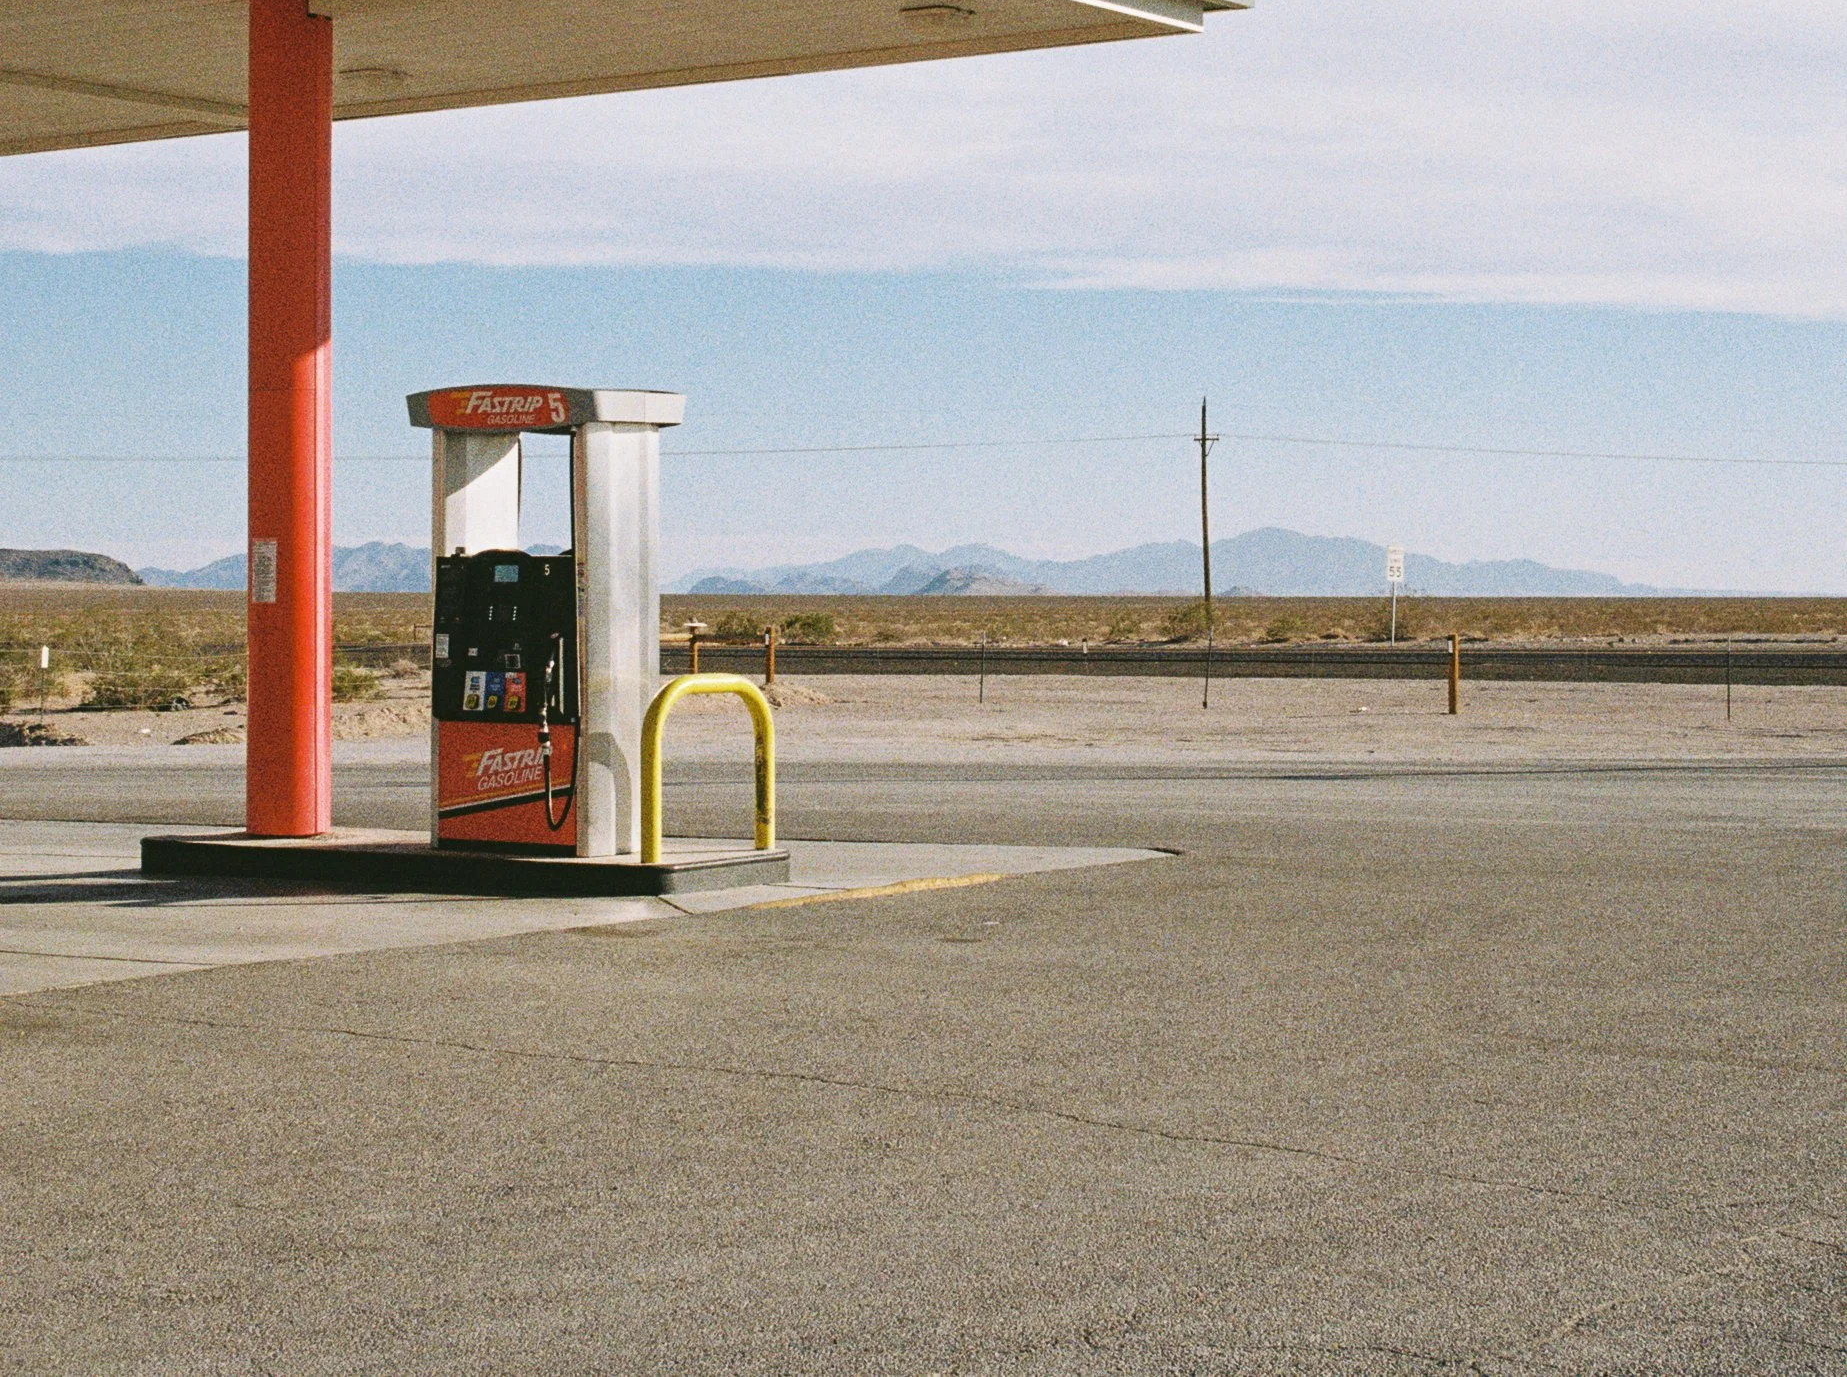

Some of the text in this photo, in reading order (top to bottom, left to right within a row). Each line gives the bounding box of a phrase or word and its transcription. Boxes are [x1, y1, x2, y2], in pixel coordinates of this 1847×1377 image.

[465, 391, 565, 423] FASTRIP 5
[487, 414, 536, 425] GASOLINE
[544, 564, 550, 576] 5
[1389, 566, 1401, 578] 55
[478, 767, 543, 791] GASOLINE
